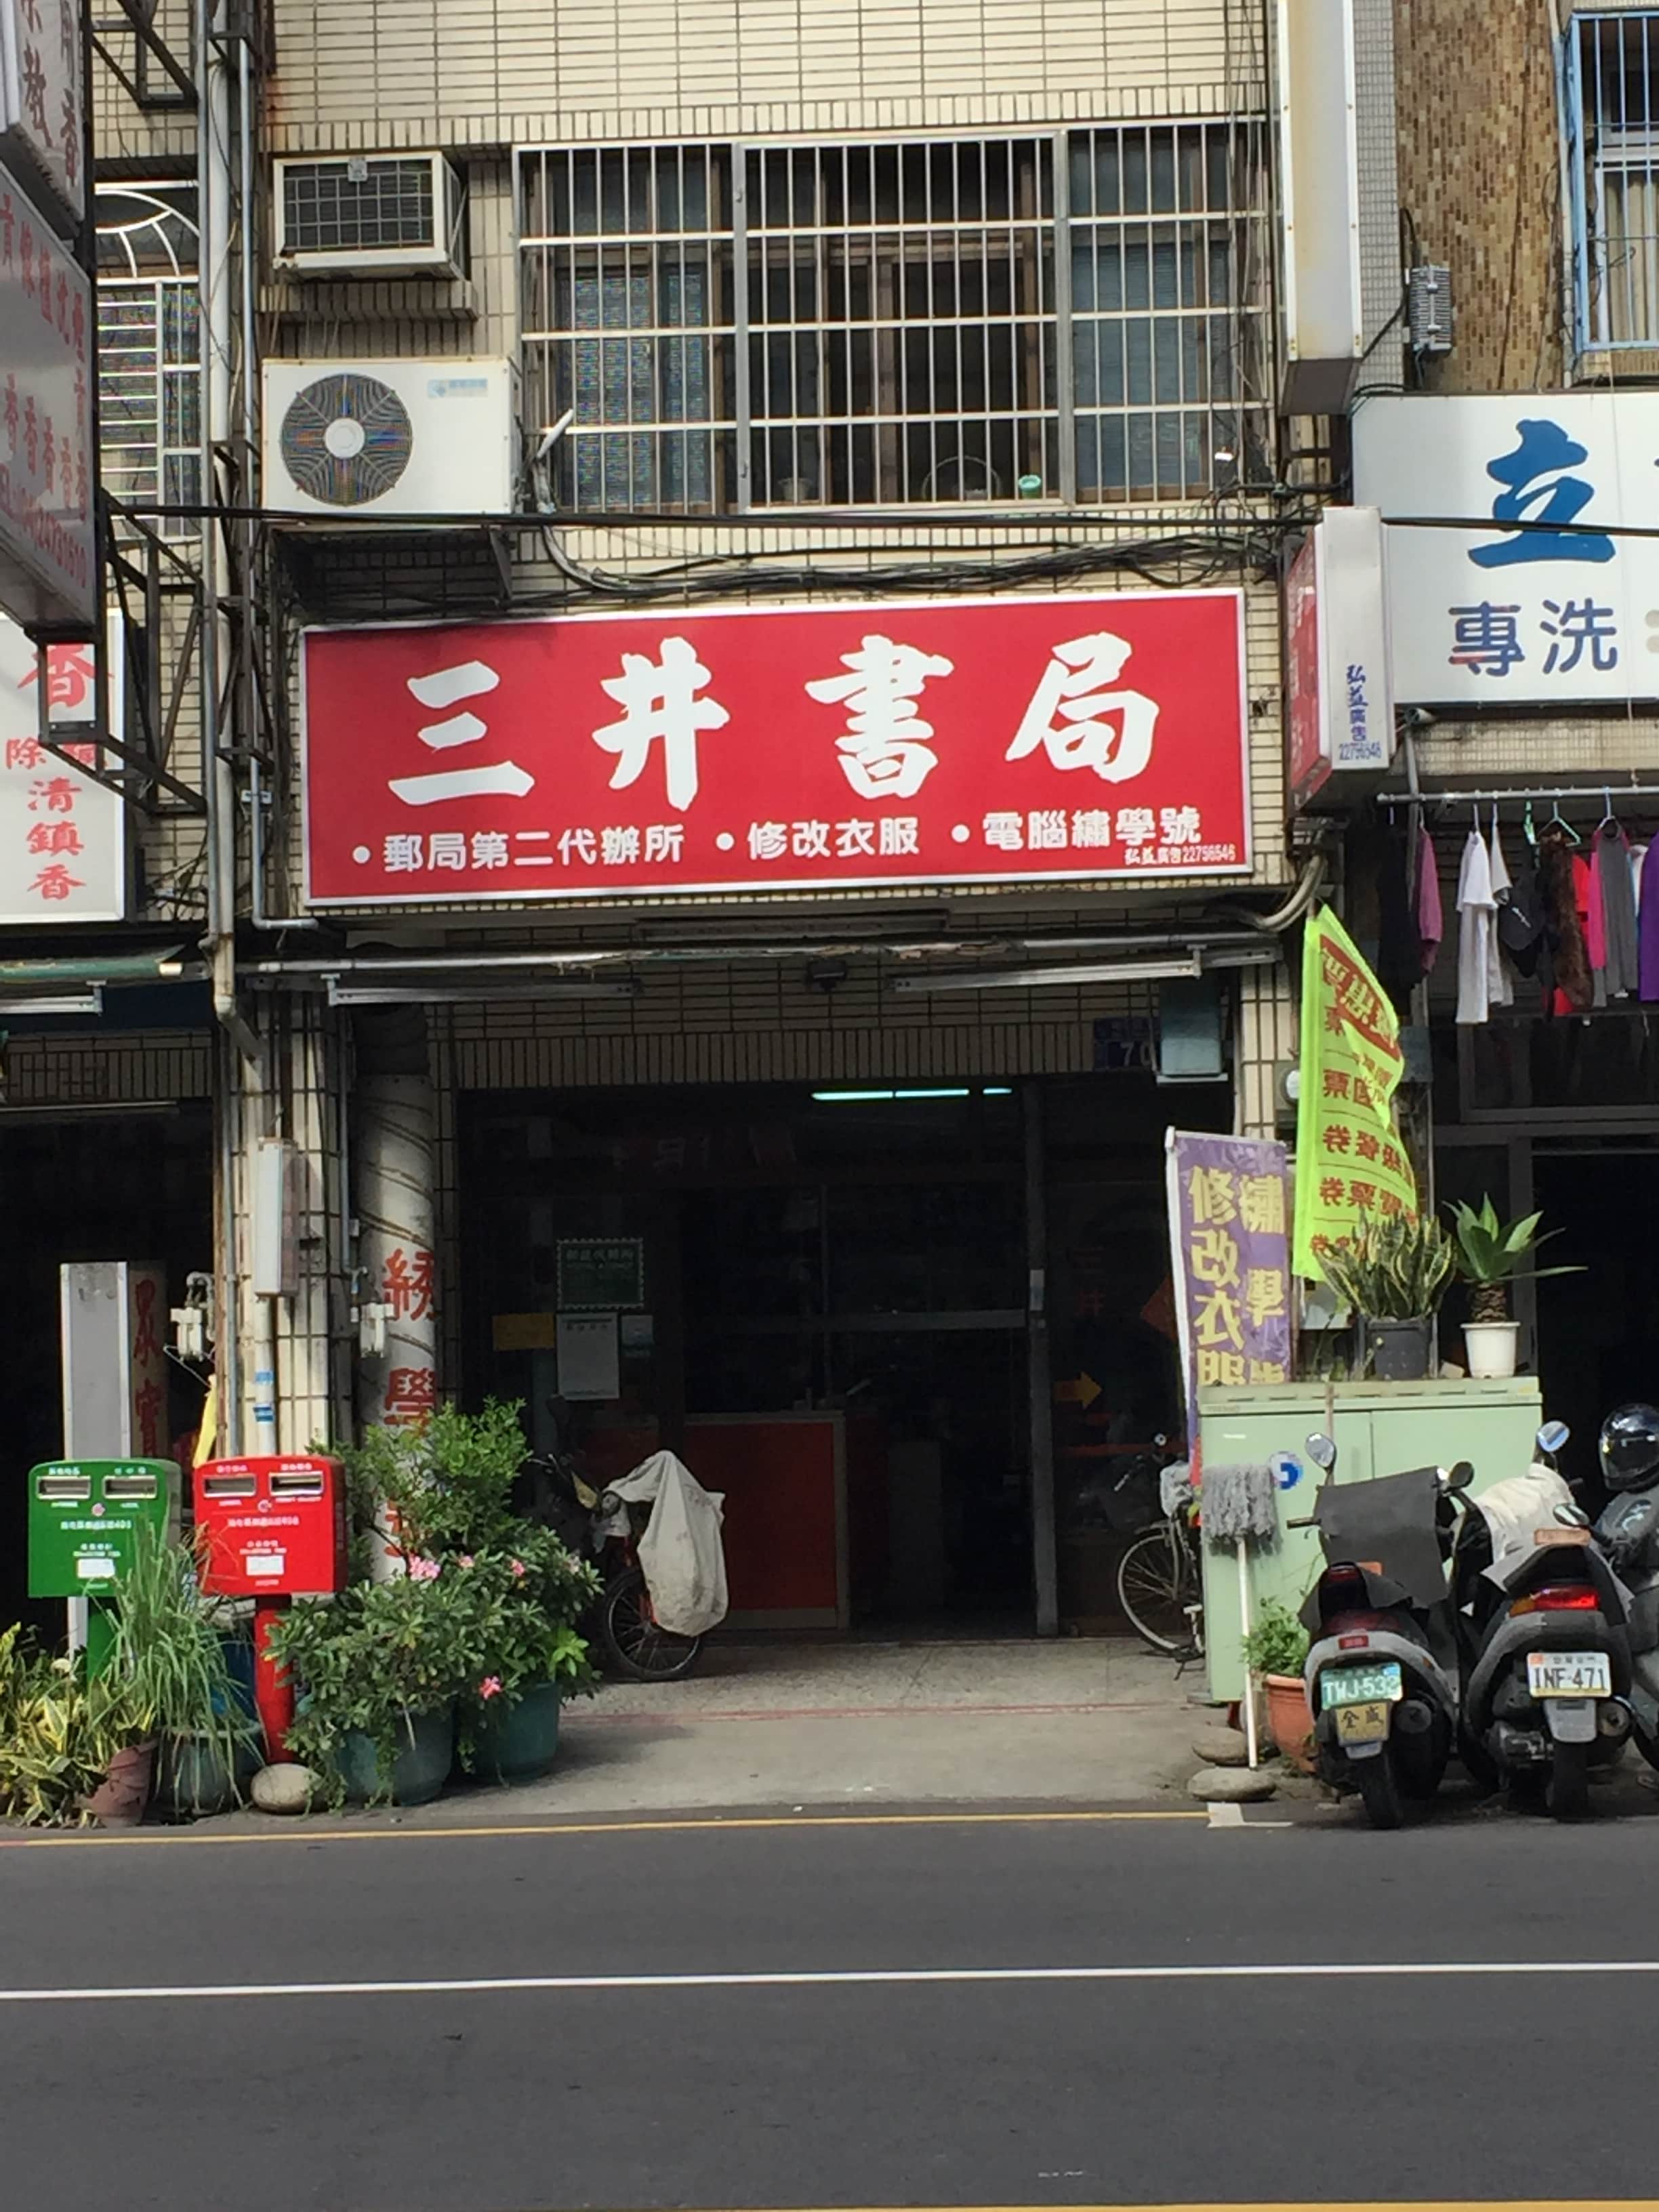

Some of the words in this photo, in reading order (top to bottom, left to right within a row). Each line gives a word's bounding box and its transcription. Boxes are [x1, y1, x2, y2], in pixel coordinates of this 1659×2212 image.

[1468, 419, 1616, 569] 立
[1449, 598, 1618, 676] 專洗
[388, 631, 1160, 811] 三井書局
[384, 824, 684, 872] 郵局第二代辦所
[747, 817, 920, 860] 修改衣服
[982, 806, 1202, 850] 電腦繡學號
